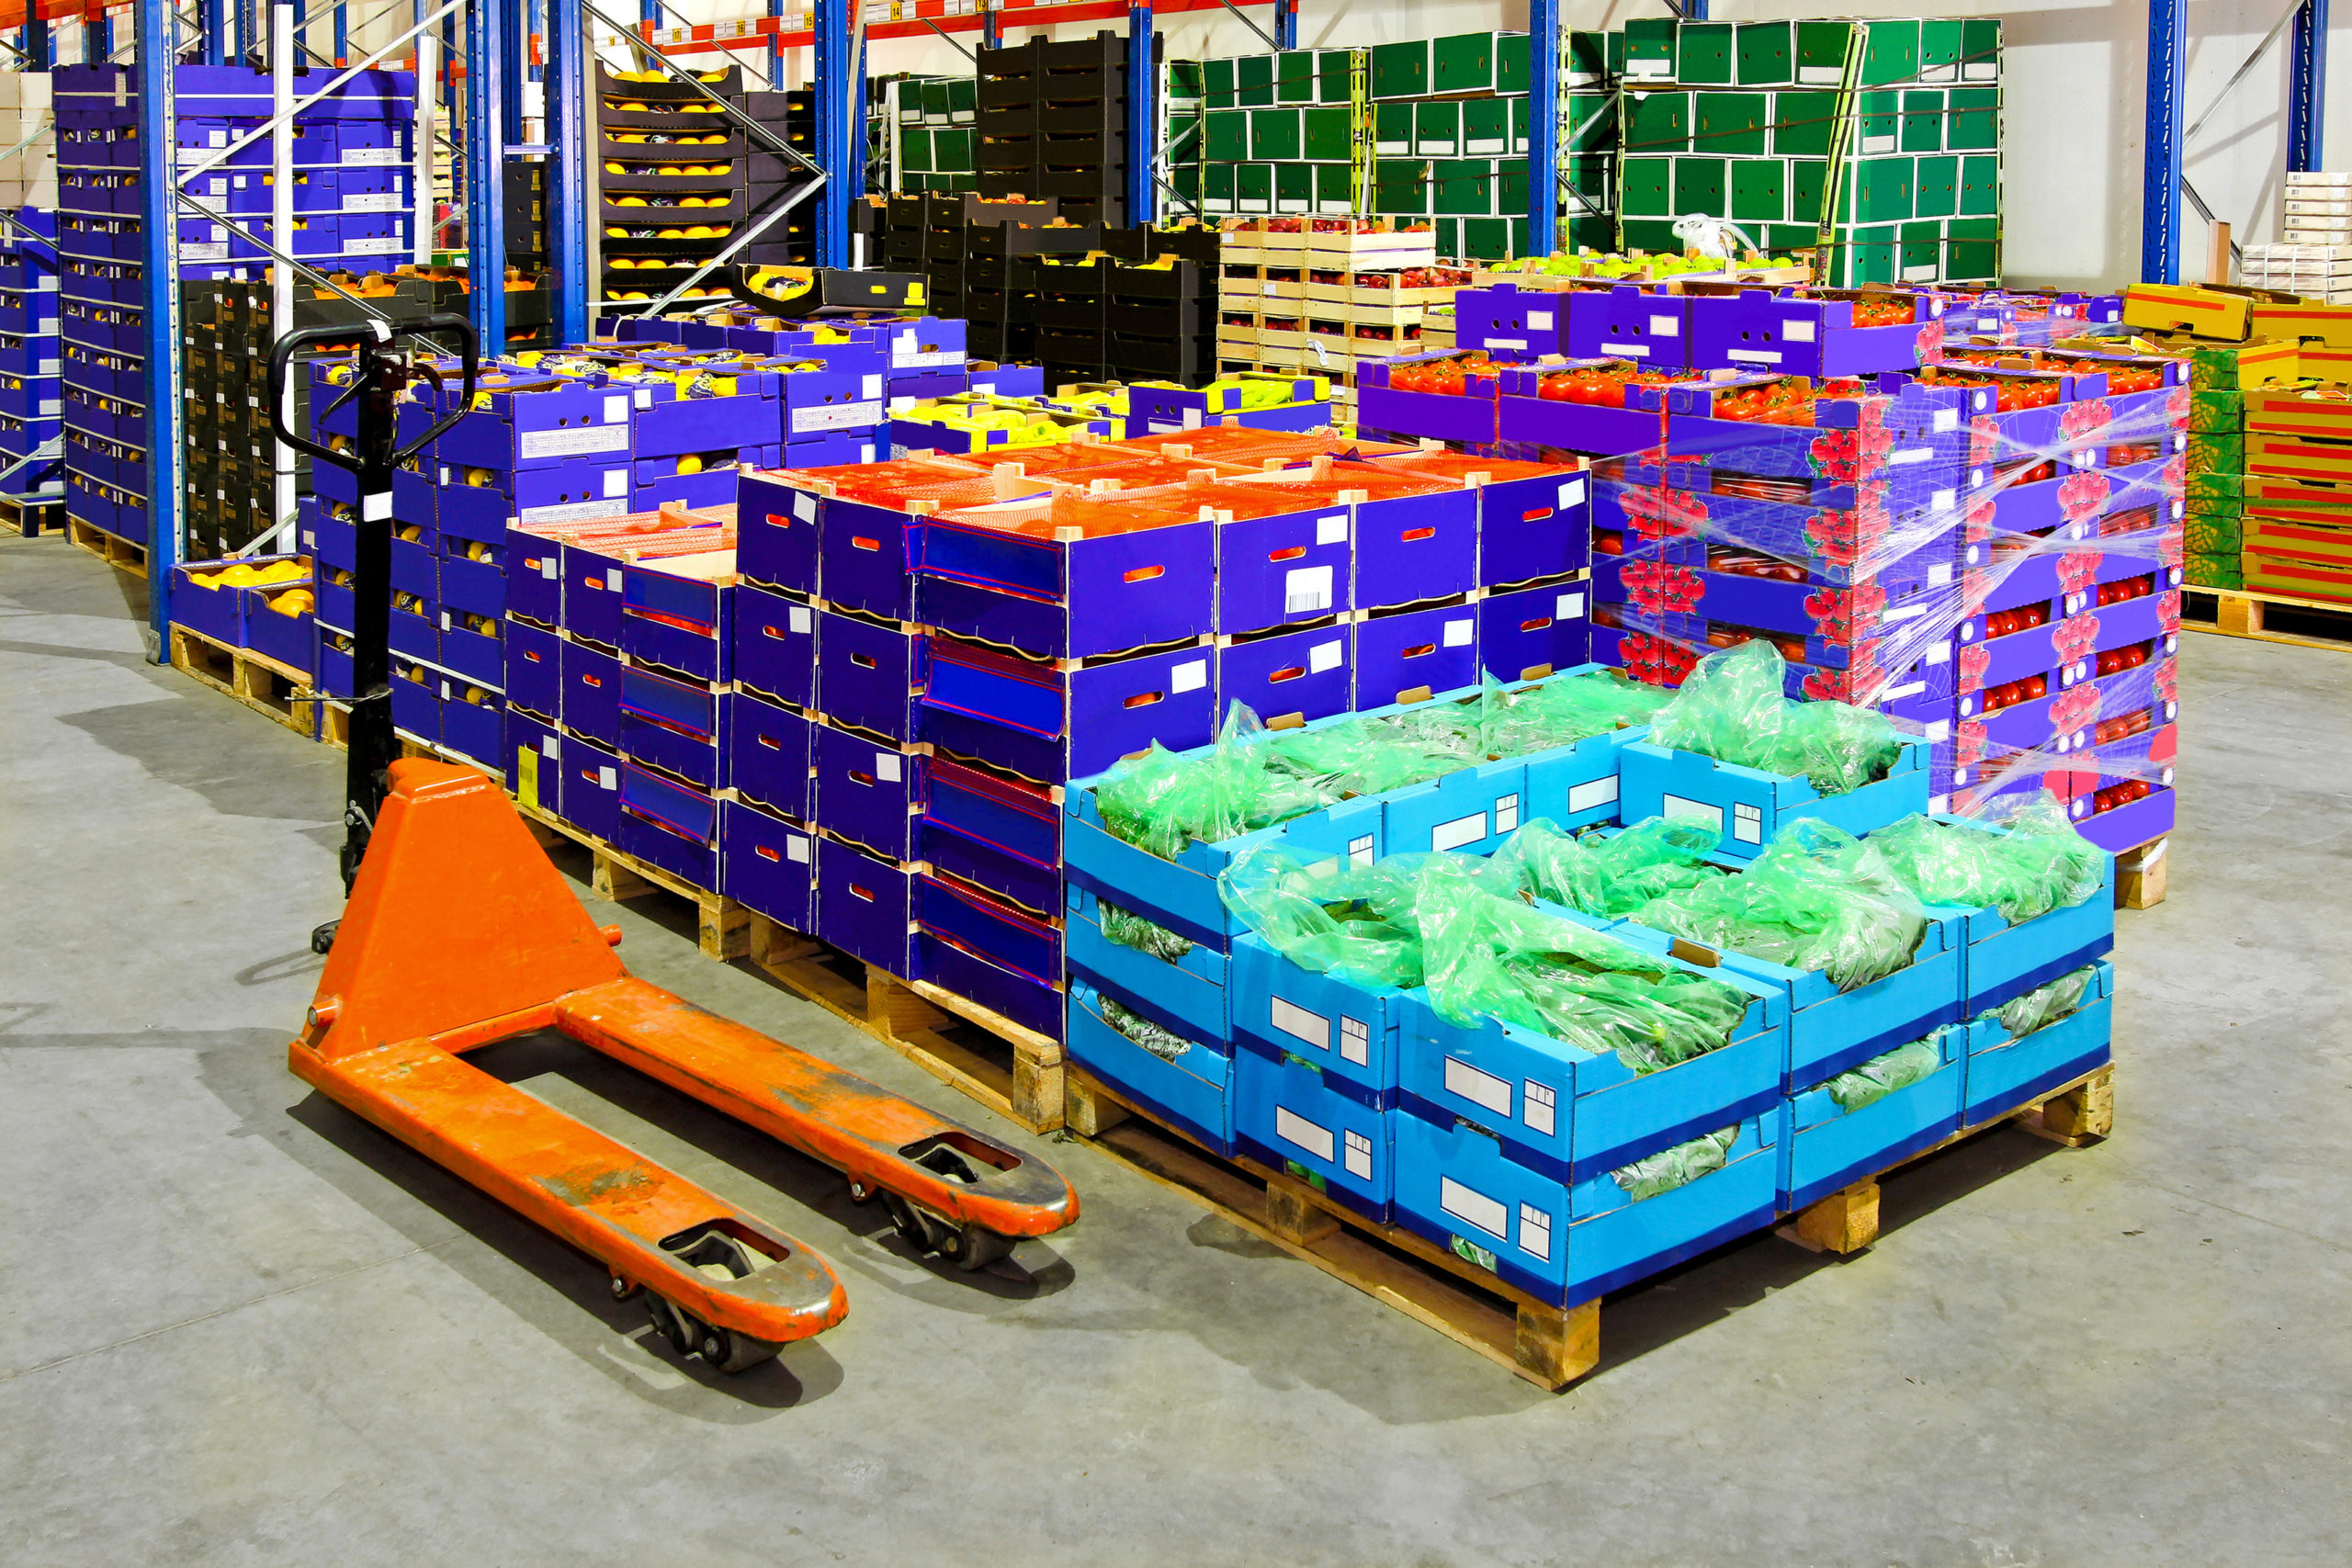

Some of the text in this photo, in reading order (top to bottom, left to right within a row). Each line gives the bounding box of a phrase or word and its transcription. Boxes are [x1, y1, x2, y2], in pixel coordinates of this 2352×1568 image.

[892, 6, 899, 17] 14
[806, 16, 813, 26] 15
[674, 30, 680, 39] 17
